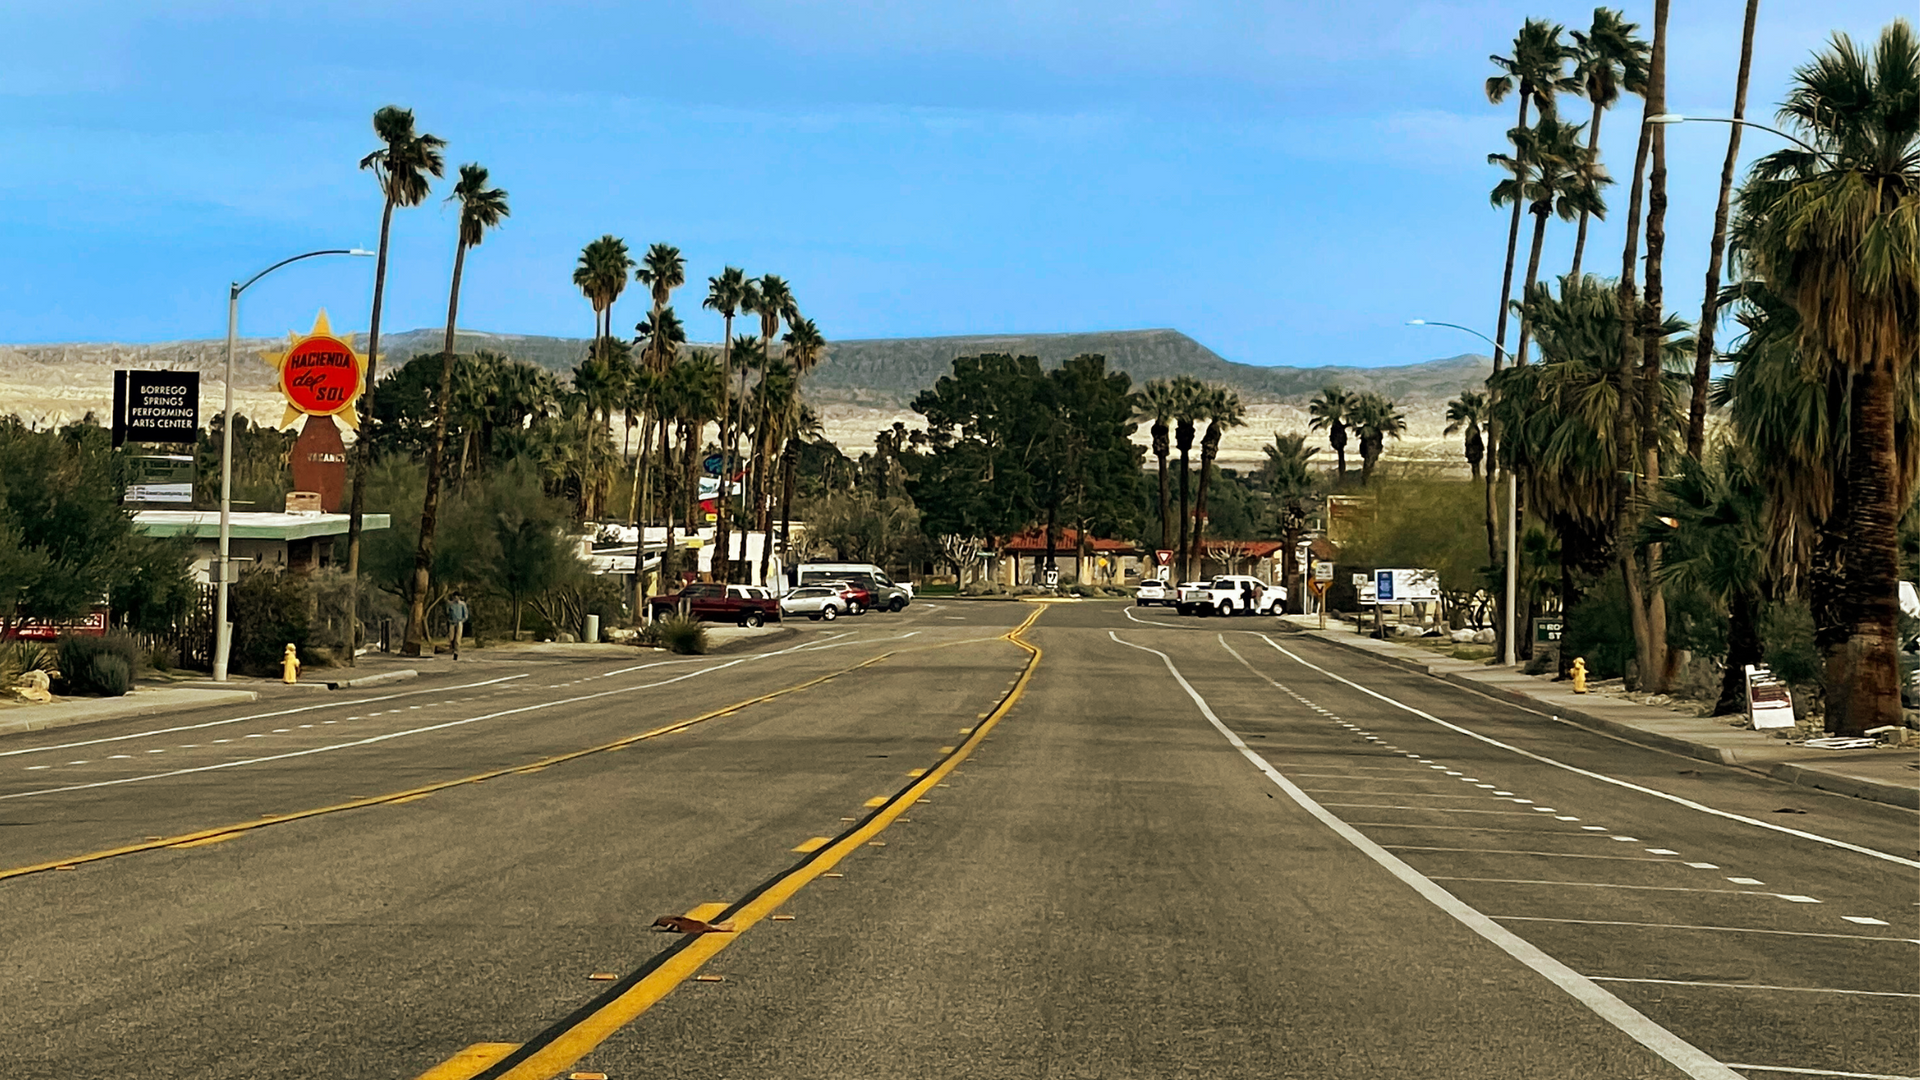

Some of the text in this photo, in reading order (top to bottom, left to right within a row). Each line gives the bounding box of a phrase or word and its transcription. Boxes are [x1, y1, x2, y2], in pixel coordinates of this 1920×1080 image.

[291, 352, 350, 370] HACIENDA
[292, 369, 327, 392] del
[140, 385, 187, 395] BORREGO
[316, 386, 345, 401] SOL
[143, 396, 184, 406] SPRINGS
[132, 407, 194, 417] PERFORMING
[132, 418, 193, 428] ARTS CENTER
